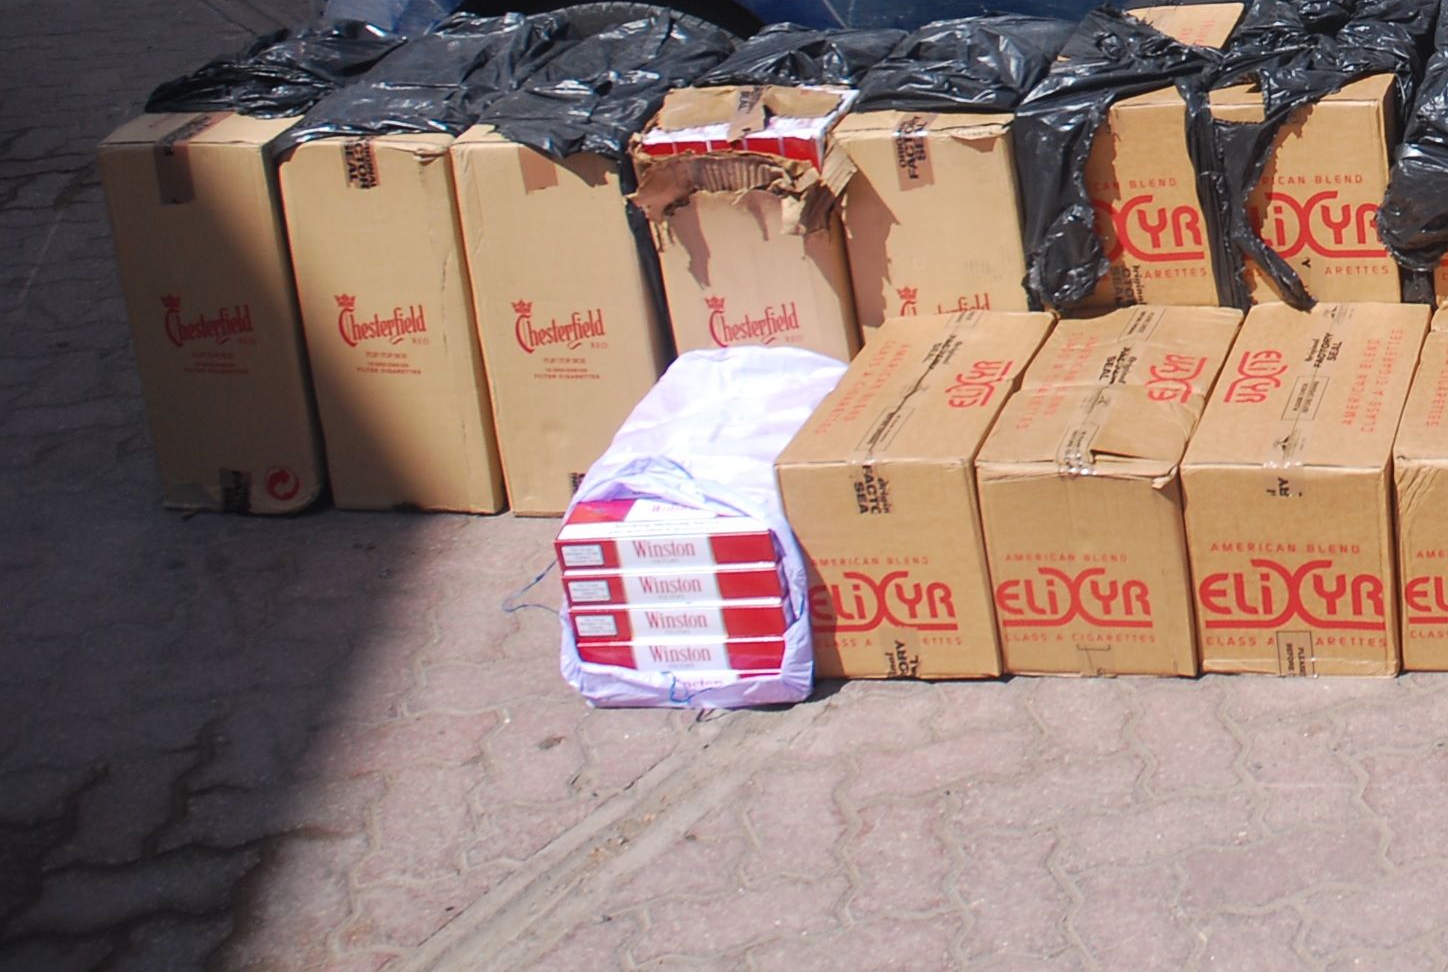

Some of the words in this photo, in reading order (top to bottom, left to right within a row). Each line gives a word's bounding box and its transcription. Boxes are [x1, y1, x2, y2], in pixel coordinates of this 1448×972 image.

[1129, 178, 1177, 189] BLEND
[1314, 174, 1364, 184] BLEND
[1144, 268, 1207, 279] ARETTES
[1324, 265, 1389, 276] ARETTES
[165, 304, 254, 347] Chesterfield
[338, 304, 427, 347] Chesterfield
[515, 308, 606, 354] Chesterfield
[708, 302, 799, 348] Chesterfield
[1313, 332, 1334, 368] FACTORY
[1326, 341, 1343, 362] SEAL
[854, 482, 869, 514] SEA
[862, 465, 882, 514] FACT
[632, 539, 696, 559] Winston
[1005, 553, 1076, 562] AMERICAN
[1083, 553, 1128, 562] BLEND
[1210, 543, 1297, 553] AMERICAN
[1306, 543, 1361, 554] BLEND
[810, 557, 880, 567] AMERICAN
[886, 556, 929, 565] BLEND
[638, 575, 702, 595] Winston
[645, 610, 708, 630] Winston
[922, 637, 962, 646] ETTES
[1005, 633, 1048, 642] CLASS
[1071, 633, 1156, 643] CIGARETTES
[1205, 636, 1257, 646] CLASS
[1267, 637, 1276, 646] A
[1315, 637, 1387, 647] ARETTES
[649, 644, 712, 664] Winston
